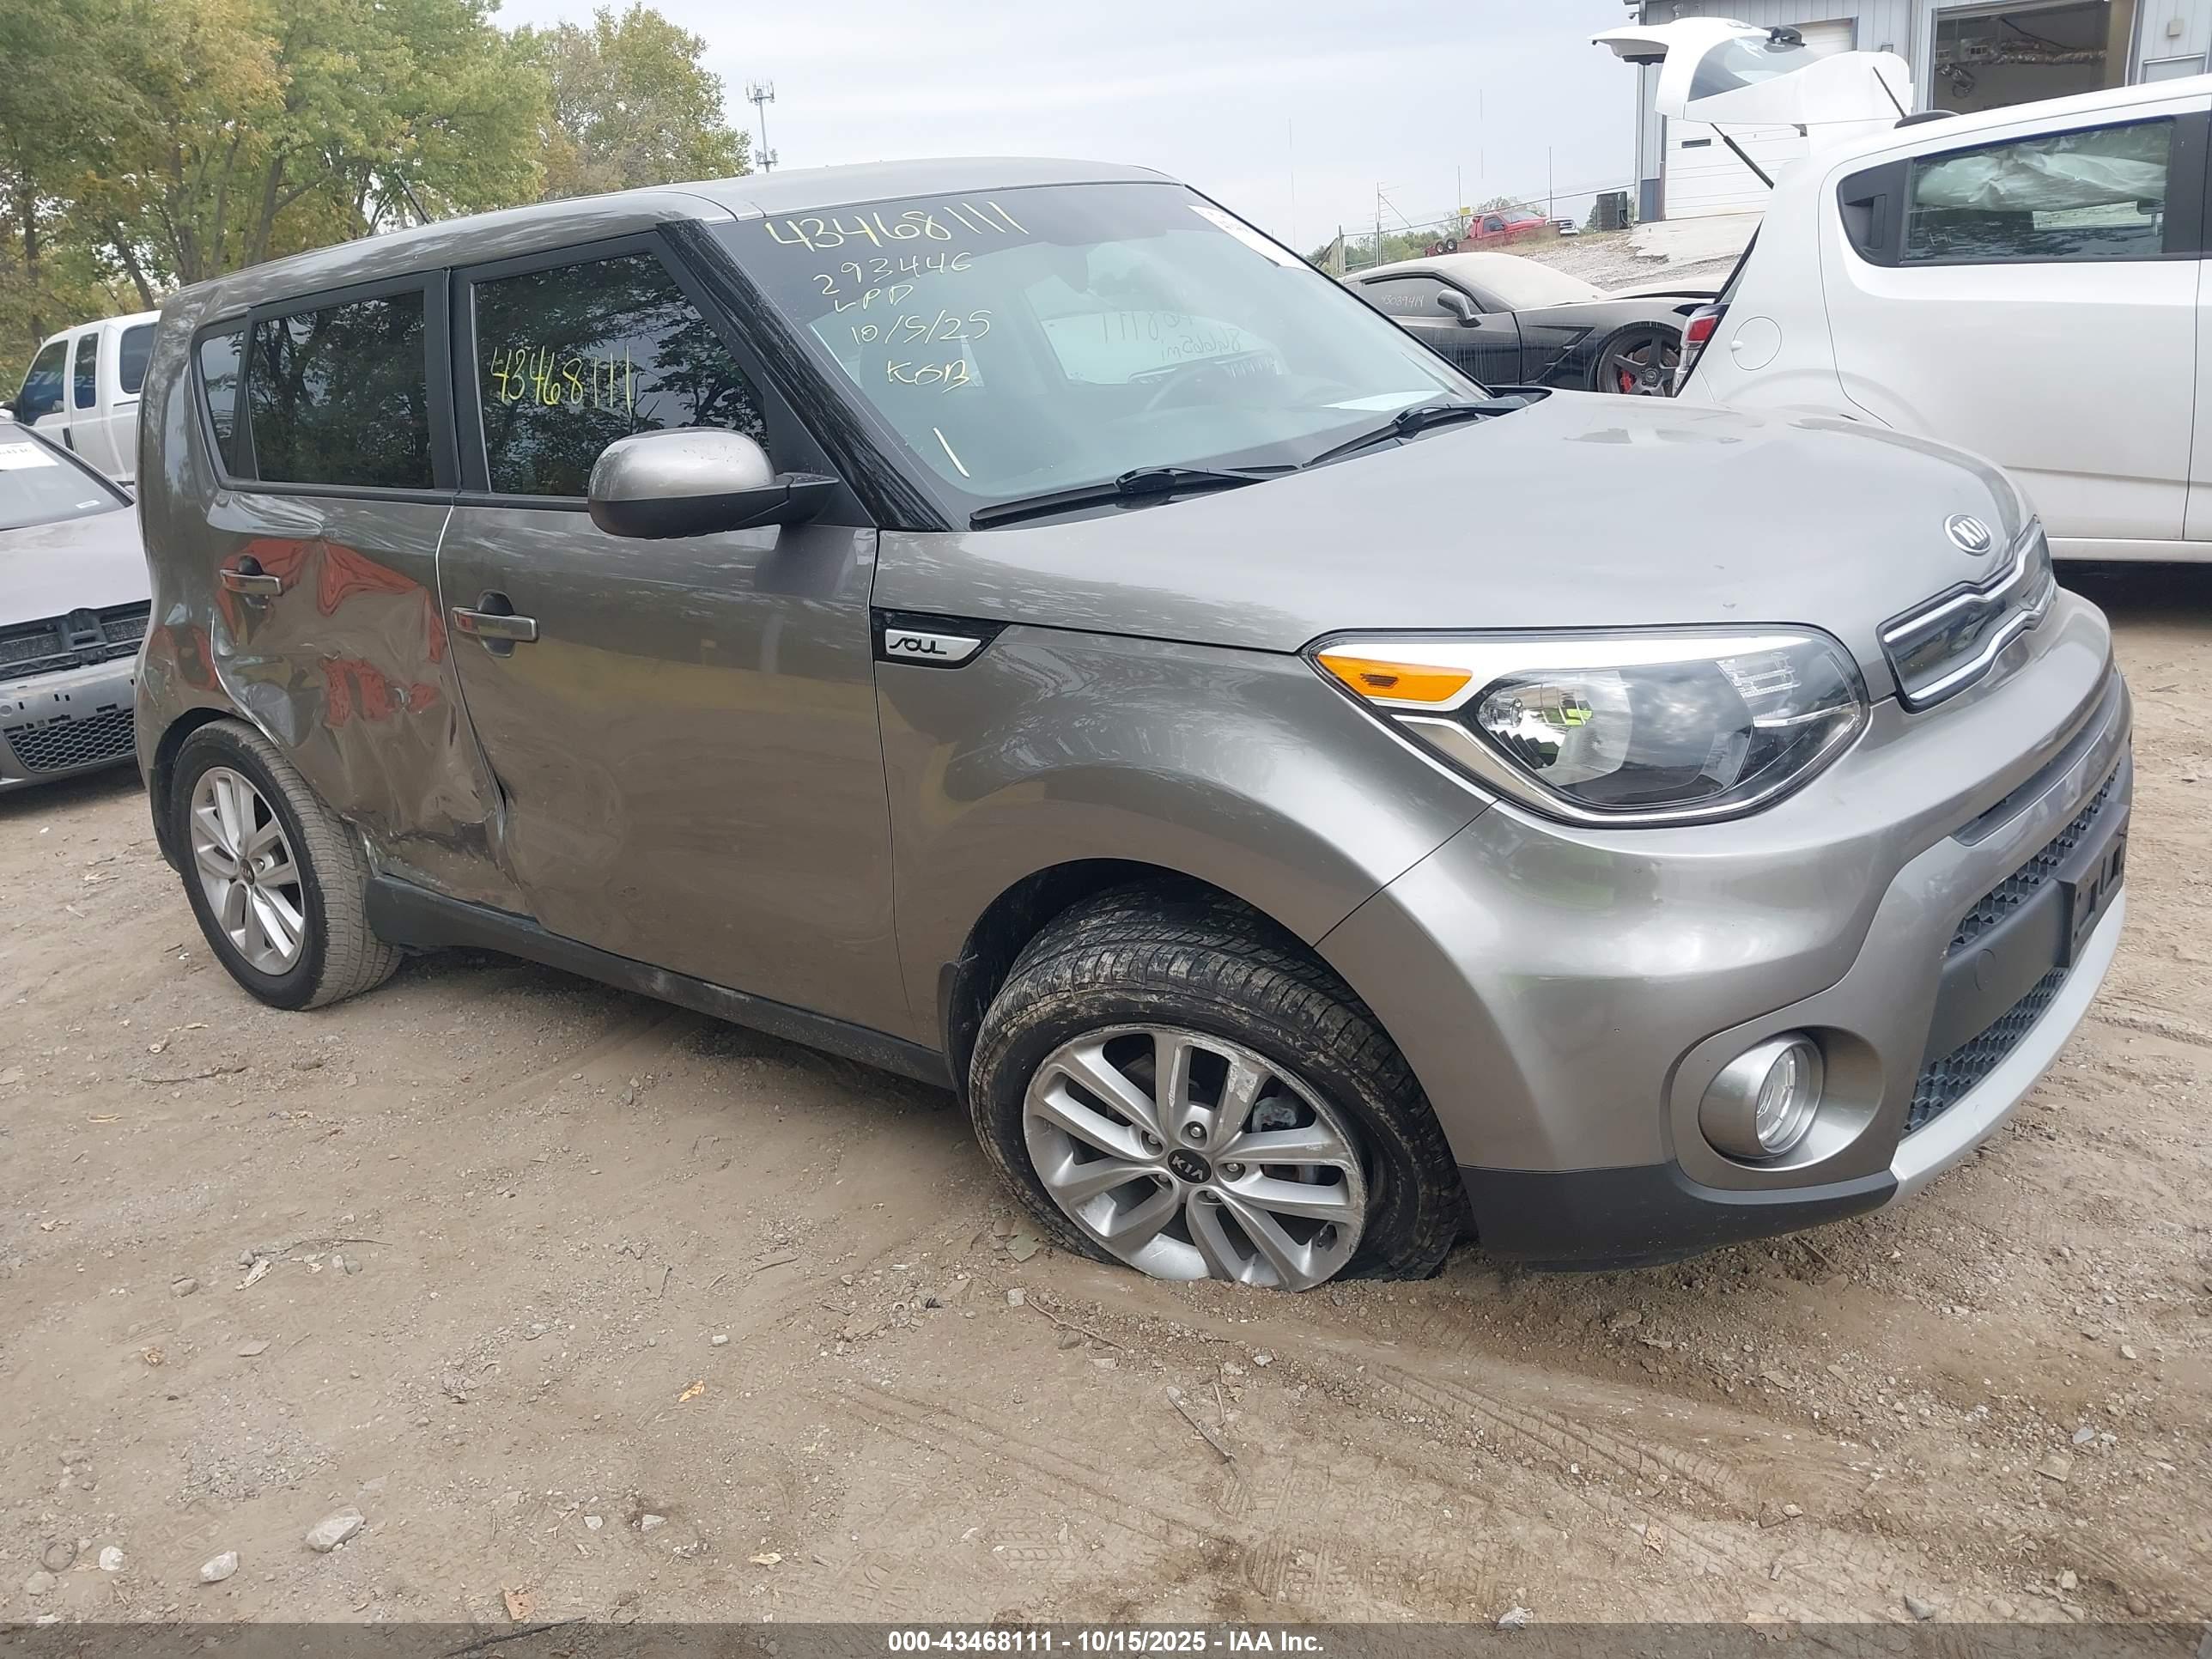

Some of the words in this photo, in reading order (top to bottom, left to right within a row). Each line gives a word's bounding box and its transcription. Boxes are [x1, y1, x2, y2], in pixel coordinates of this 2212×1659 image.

[764, 200, 1030, 252] 43468111
[812, 252, 973, 295] 293446
[851, 309, 993, 345] 10/5/25
[489, 345, 634, 418] 43468111
[889, 637, 947, 655] SOUL
[1171, 1154, 1203, 1181] KIA
